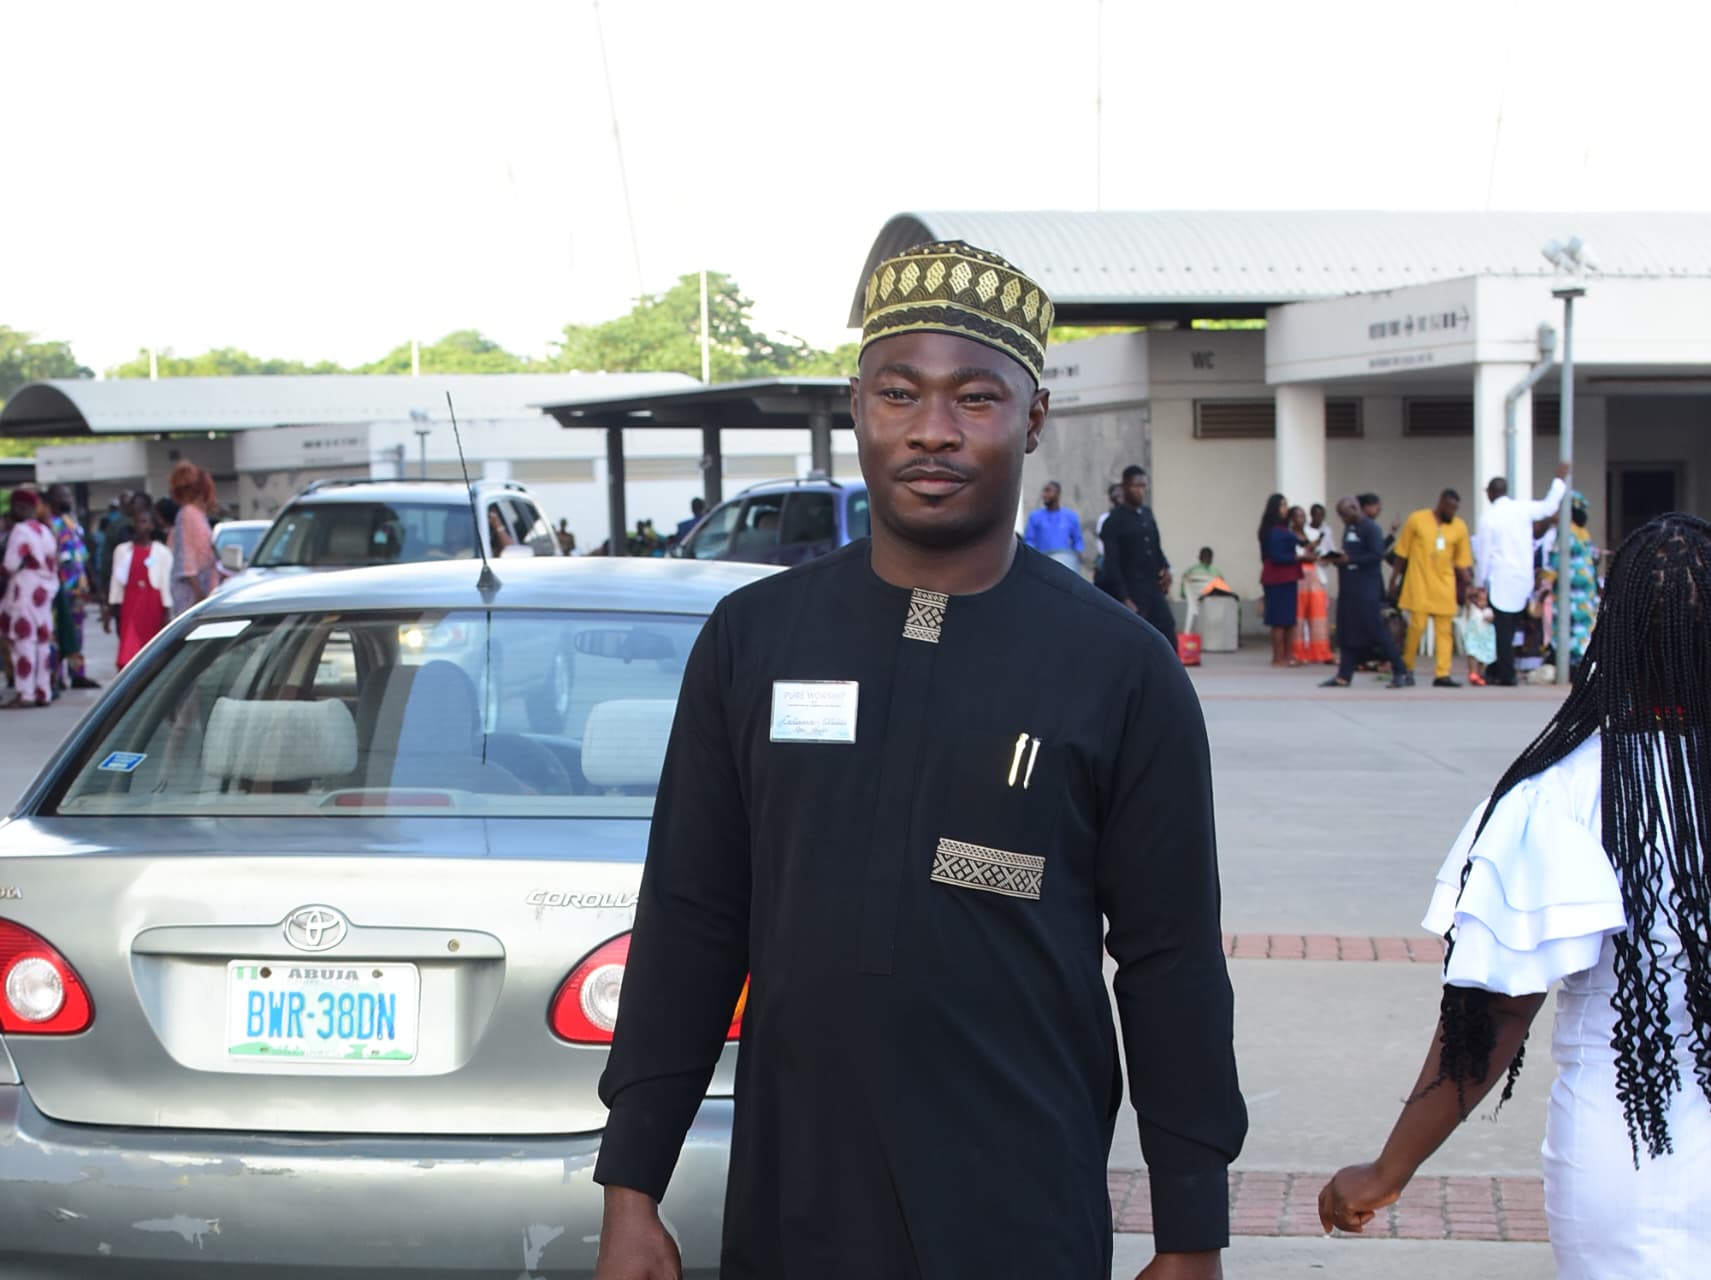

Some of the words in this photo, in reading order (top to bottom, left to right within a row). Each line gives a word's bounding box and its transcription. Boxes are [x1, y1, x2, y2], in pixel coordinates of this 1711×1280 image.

[1191, 351, 1216, 369] WC
[288, 968, 360, 980] ABUJA
[247, 990, 396, 1040] BWR-38DN
